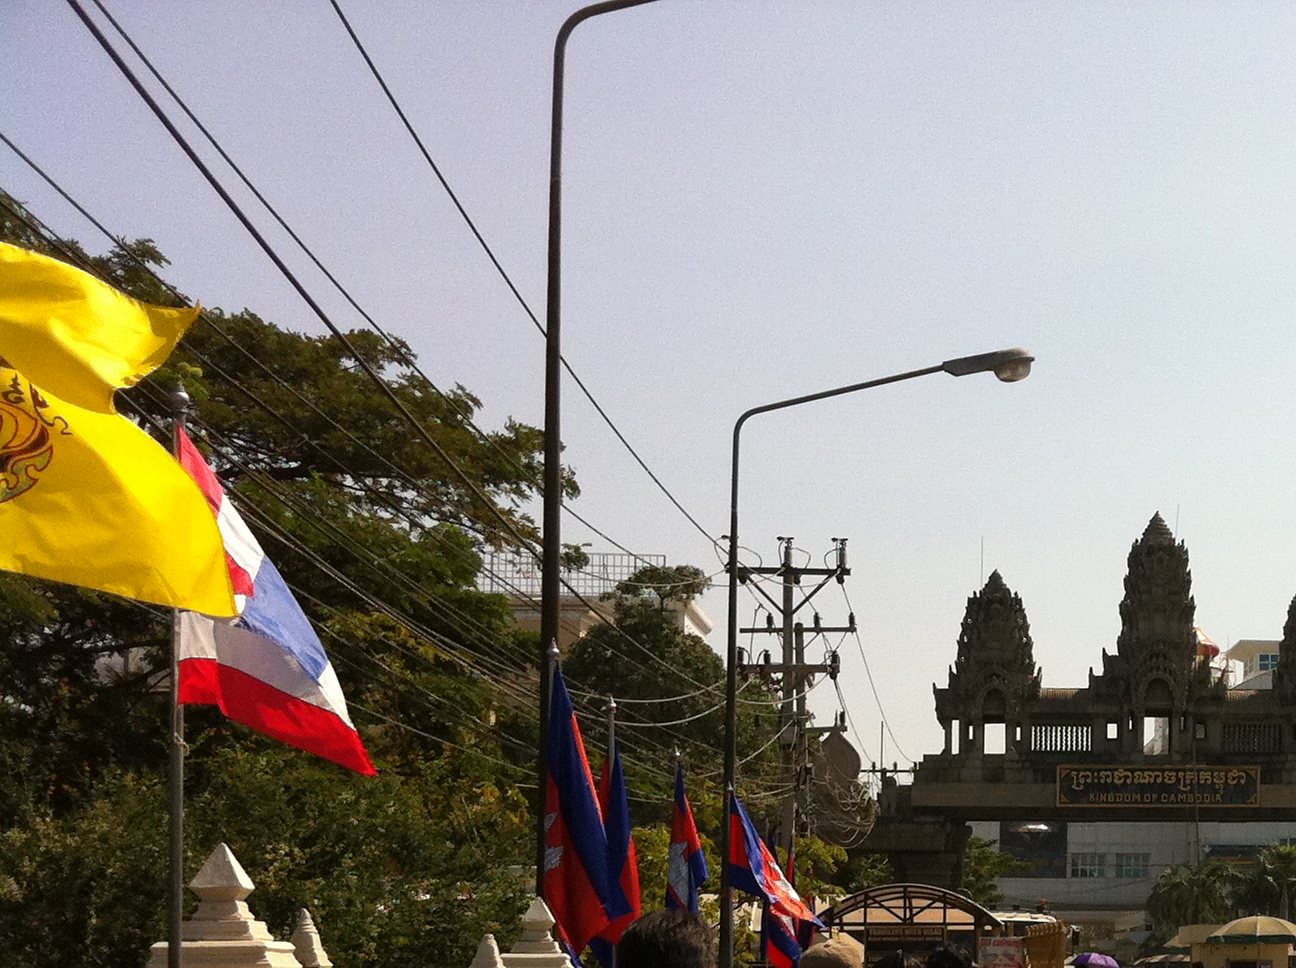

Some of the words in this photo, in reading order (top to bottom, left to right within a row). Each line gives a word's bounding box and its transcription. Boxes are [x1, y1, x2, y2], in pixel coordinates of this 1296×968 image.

[1089, 792, 1140, 803] KINGDOM
[1144, 792, 1159, 803] OF
[1161, 792, 1223, 803] CAMBODIA
